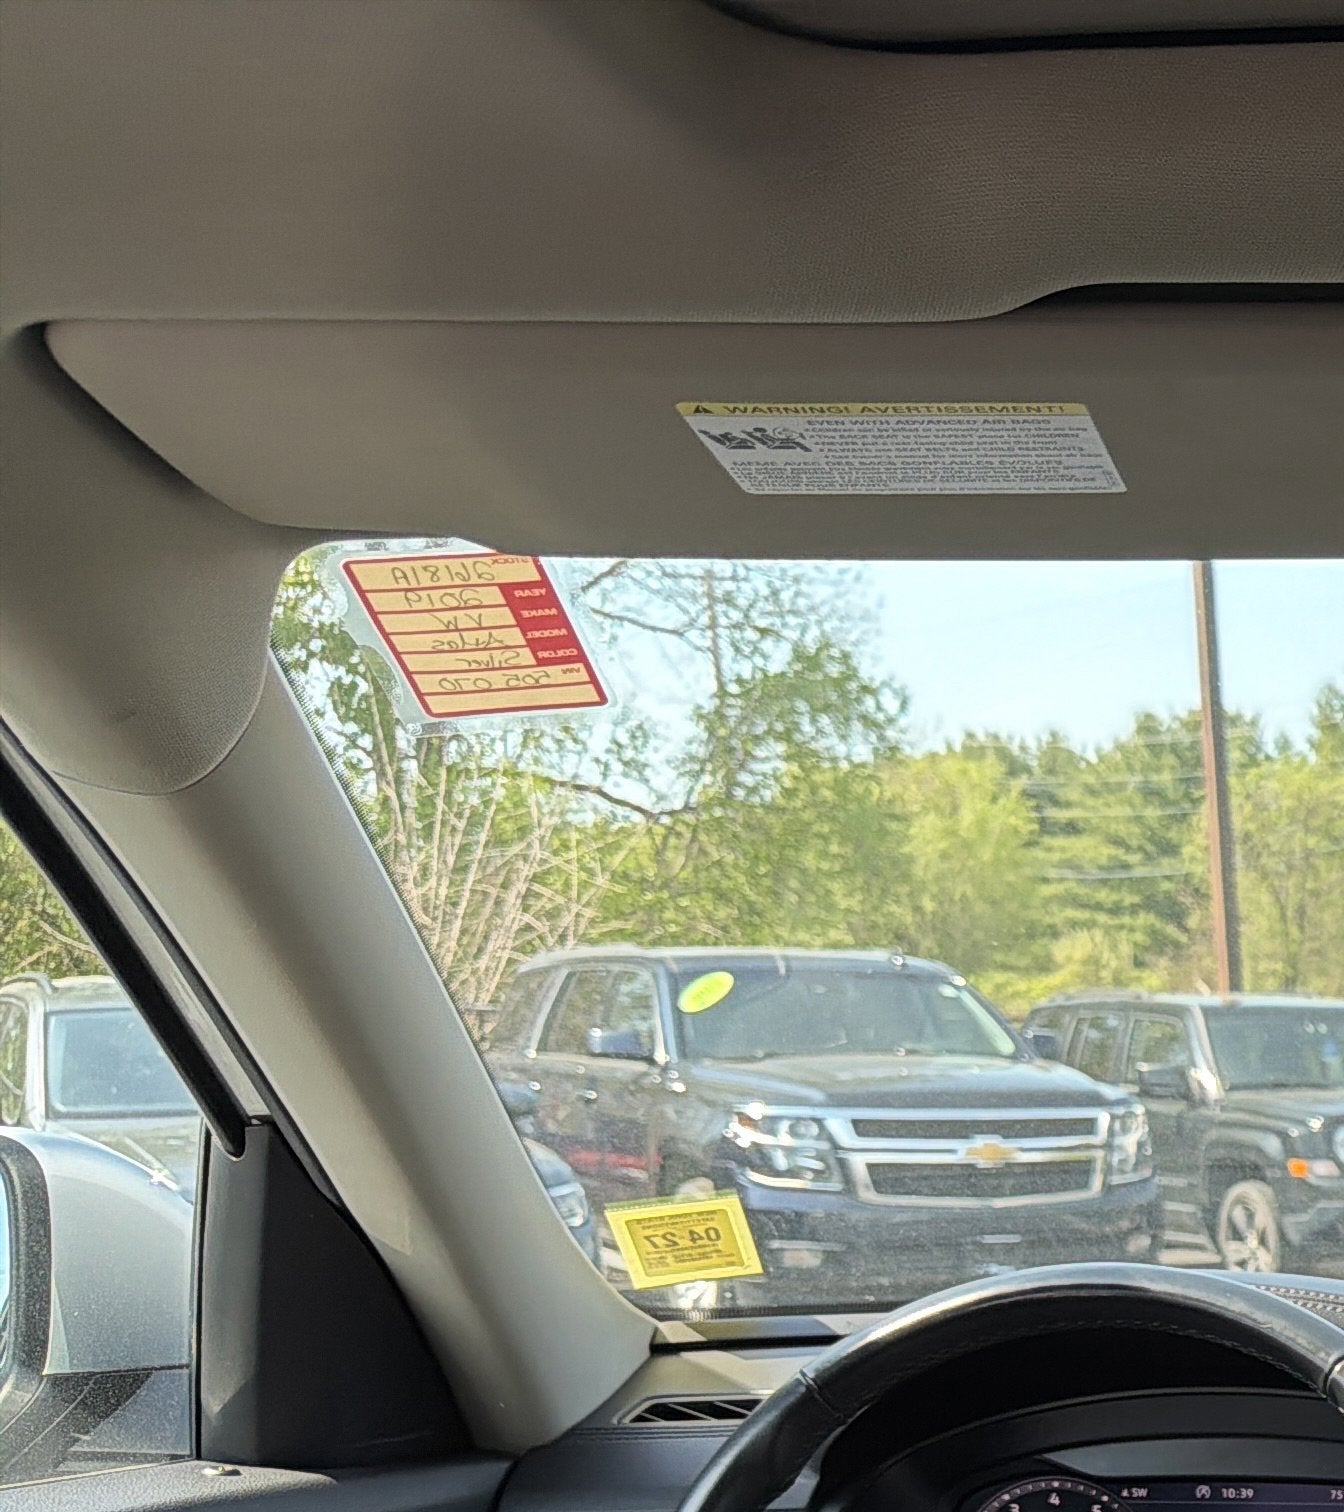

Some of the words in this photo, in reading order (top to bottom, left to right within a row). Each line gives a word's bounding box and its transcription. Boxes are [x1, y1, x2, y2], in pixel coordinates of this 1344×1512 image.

[722, 405, 850, 415] WARNING!
[860, 405, 1065, 415] AVERTISSEMENT!
[1132, 1488, 1148, 1498] SW
[1221, 1488, 1254, 1499] 10:39
[1048, 1493, 1060, 1507] 4
